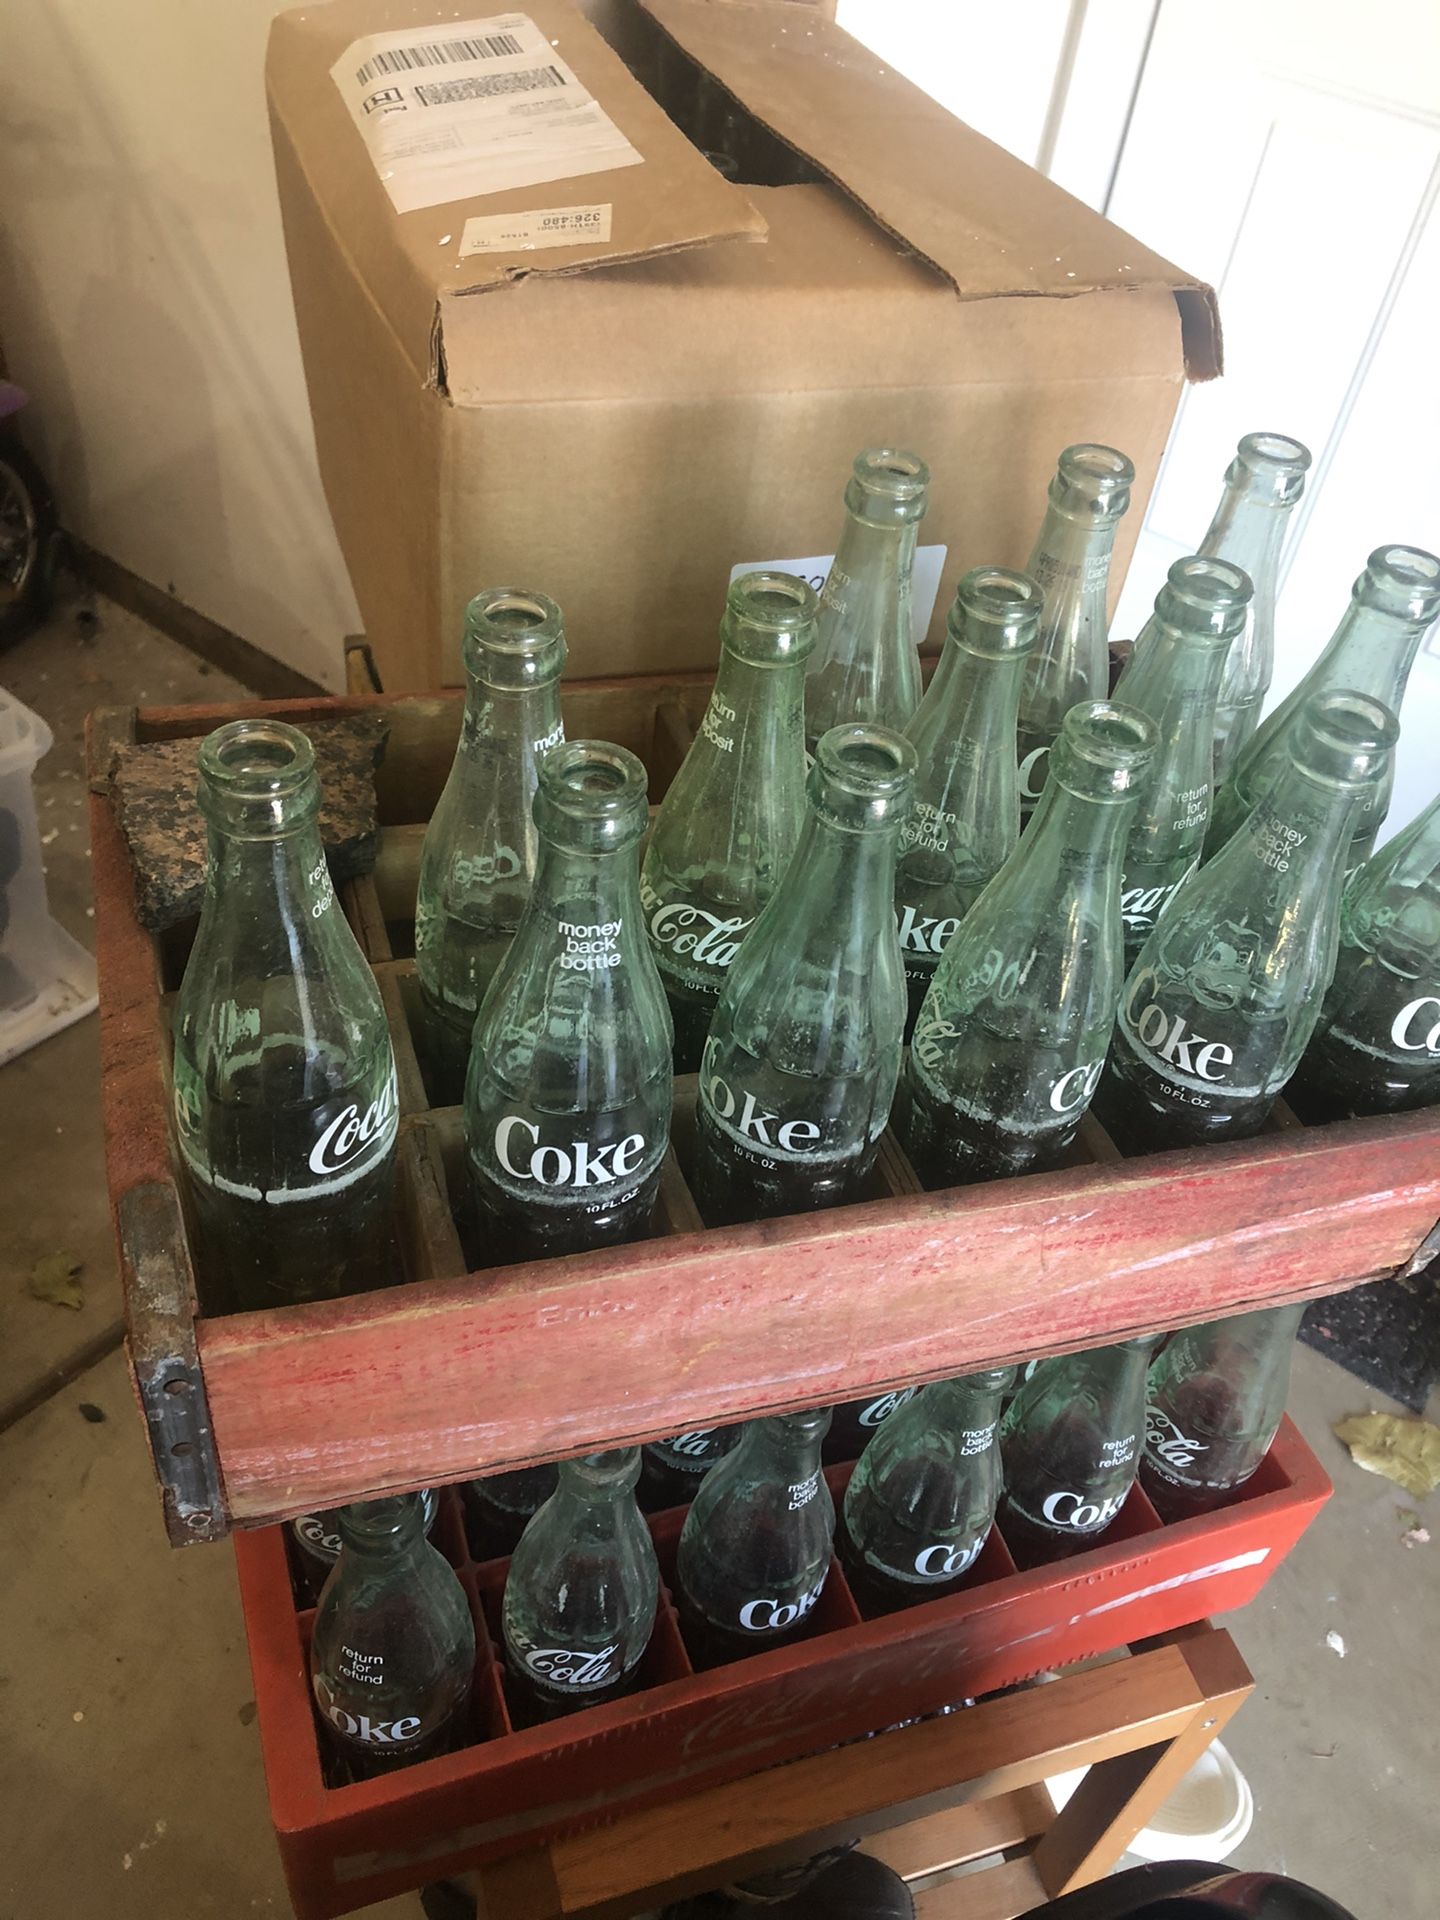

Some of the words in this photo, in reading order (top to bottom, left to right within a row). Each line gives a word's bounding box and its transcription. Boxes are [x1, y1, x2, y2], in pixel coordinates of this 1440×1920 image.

[1176, 783, 1209, 803] return
[1187, 801, 1202, 815] for
[919, 816, 941, 836] for
[1173, 808, 1208, 831] refund
[558, 918, 622, 938] money
[893, 905, 961, 954] ke
[566, 936, 617, 955] back
[560, 952, 622, 972] bottle
[1126, 967, 1234, 1082] Coke
[1159, 1083, 1172, 1095] 10
[494, 1115, 646, 1188] Coke
[733, 1144, 744, 1157] 10
[585, 1204, 600, 1214] 10
[1102, 1434, 1136, 1450] return
[1098, 1451, 1134, 1469] refund
[1112, 1447, 1128, 1459] for
[341, 1645, 384, 1665] return
[338, 1664, 384, 1686] refund
[352, 1661, 372, 1674] for
